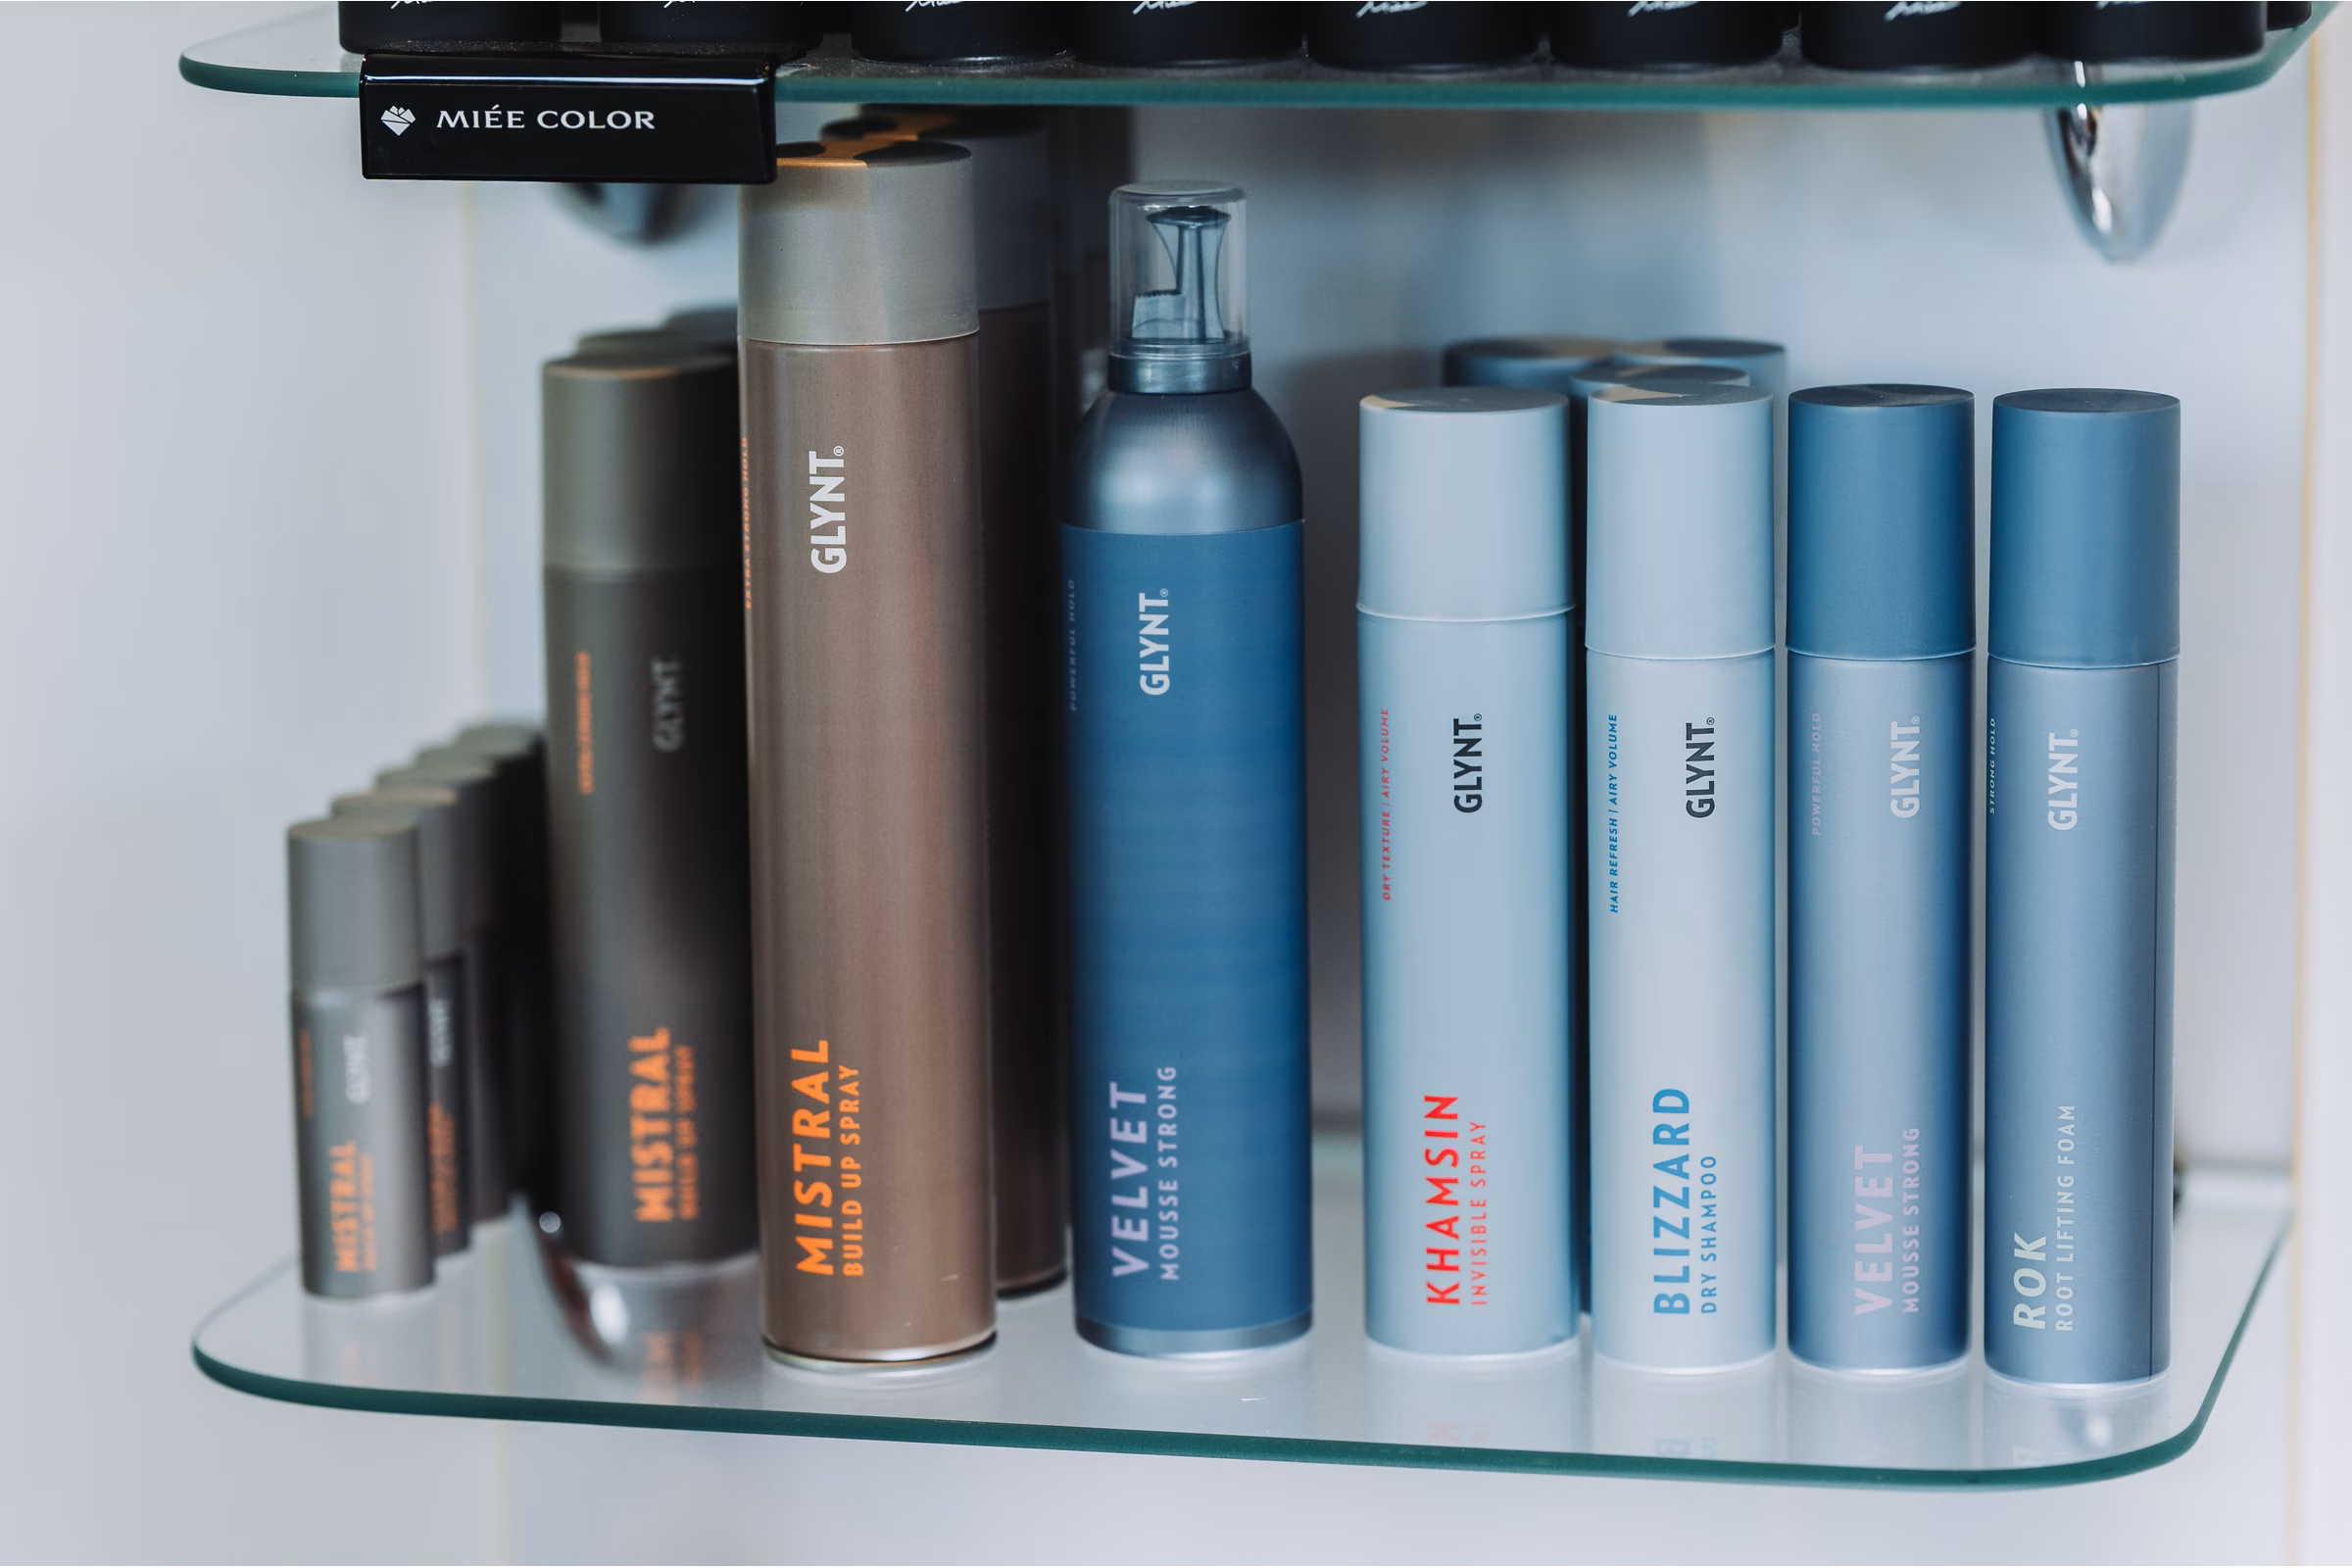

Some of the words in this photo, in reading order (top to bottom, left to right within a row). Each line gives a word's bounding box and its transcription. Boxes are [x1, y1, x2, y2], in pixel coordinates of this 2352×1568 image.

[436, 104, 525, 129] MIÉE
[536, 109, 656, 129] COLOR
[1380, 709, 1389, 761] VOLUME
[1608, 713, 1617, 769] VOLUME
[1812, 712, 1822, 753] HOLD
[1380, 767, 1390, 799] AIRY
[1608, 773, 1618, 806] AIRY
[1812, 758, 1822, 836] POWERFUL
[1381, 809, 1391, 870] TEXTURE
[1609, 817, 1618, 877] REFRESH
[1382, 874, 1391, 901] DRY
[1609, 882, 1618, 913] HAIR
[628, 1026, 675, 1222] MISTRAL
[839, 1065, 860, 1145] SPRAY
[1156, 1066, 1178, 1168] STRONG
[2057, 1104, 2076, 1165] FOAM
[790, 1040, 834, 1275] MISTRAL
[840, 1156, 861, 1189] UP
[1109, 1081, 1151, 1276] VELVET
[1469, 1120, 1488, 1188] SPRAY
[1902, 1128, 1920, 1216] STRONG
[330, 1140, 358, 1271] MISTRAL
[841, 1200, 863, 1276] BUILD
[1157, 1179, 1179, 1280] MOUSSE
[1424, 1095, 1460, 1305] KHAMSIN
[1652, 1088, 1690, 1315] BLIZZARD
[1700, 1155, 1718, 1262] SHAMPOO
[1854, 1145, 1893, 1316] VELVET
[2056, 1175, 2075, 1263] LIFTING
[1470, 1199, 1488, 1305] INVISIBLE
[1902, 1226, 1920, 1314] MOUSSE
[2013, 1232, 2047, 1330] ROK
[1700, 1273, 1718, 1314] DRY
[2055, 1273, 2074, 1332] ROOT
